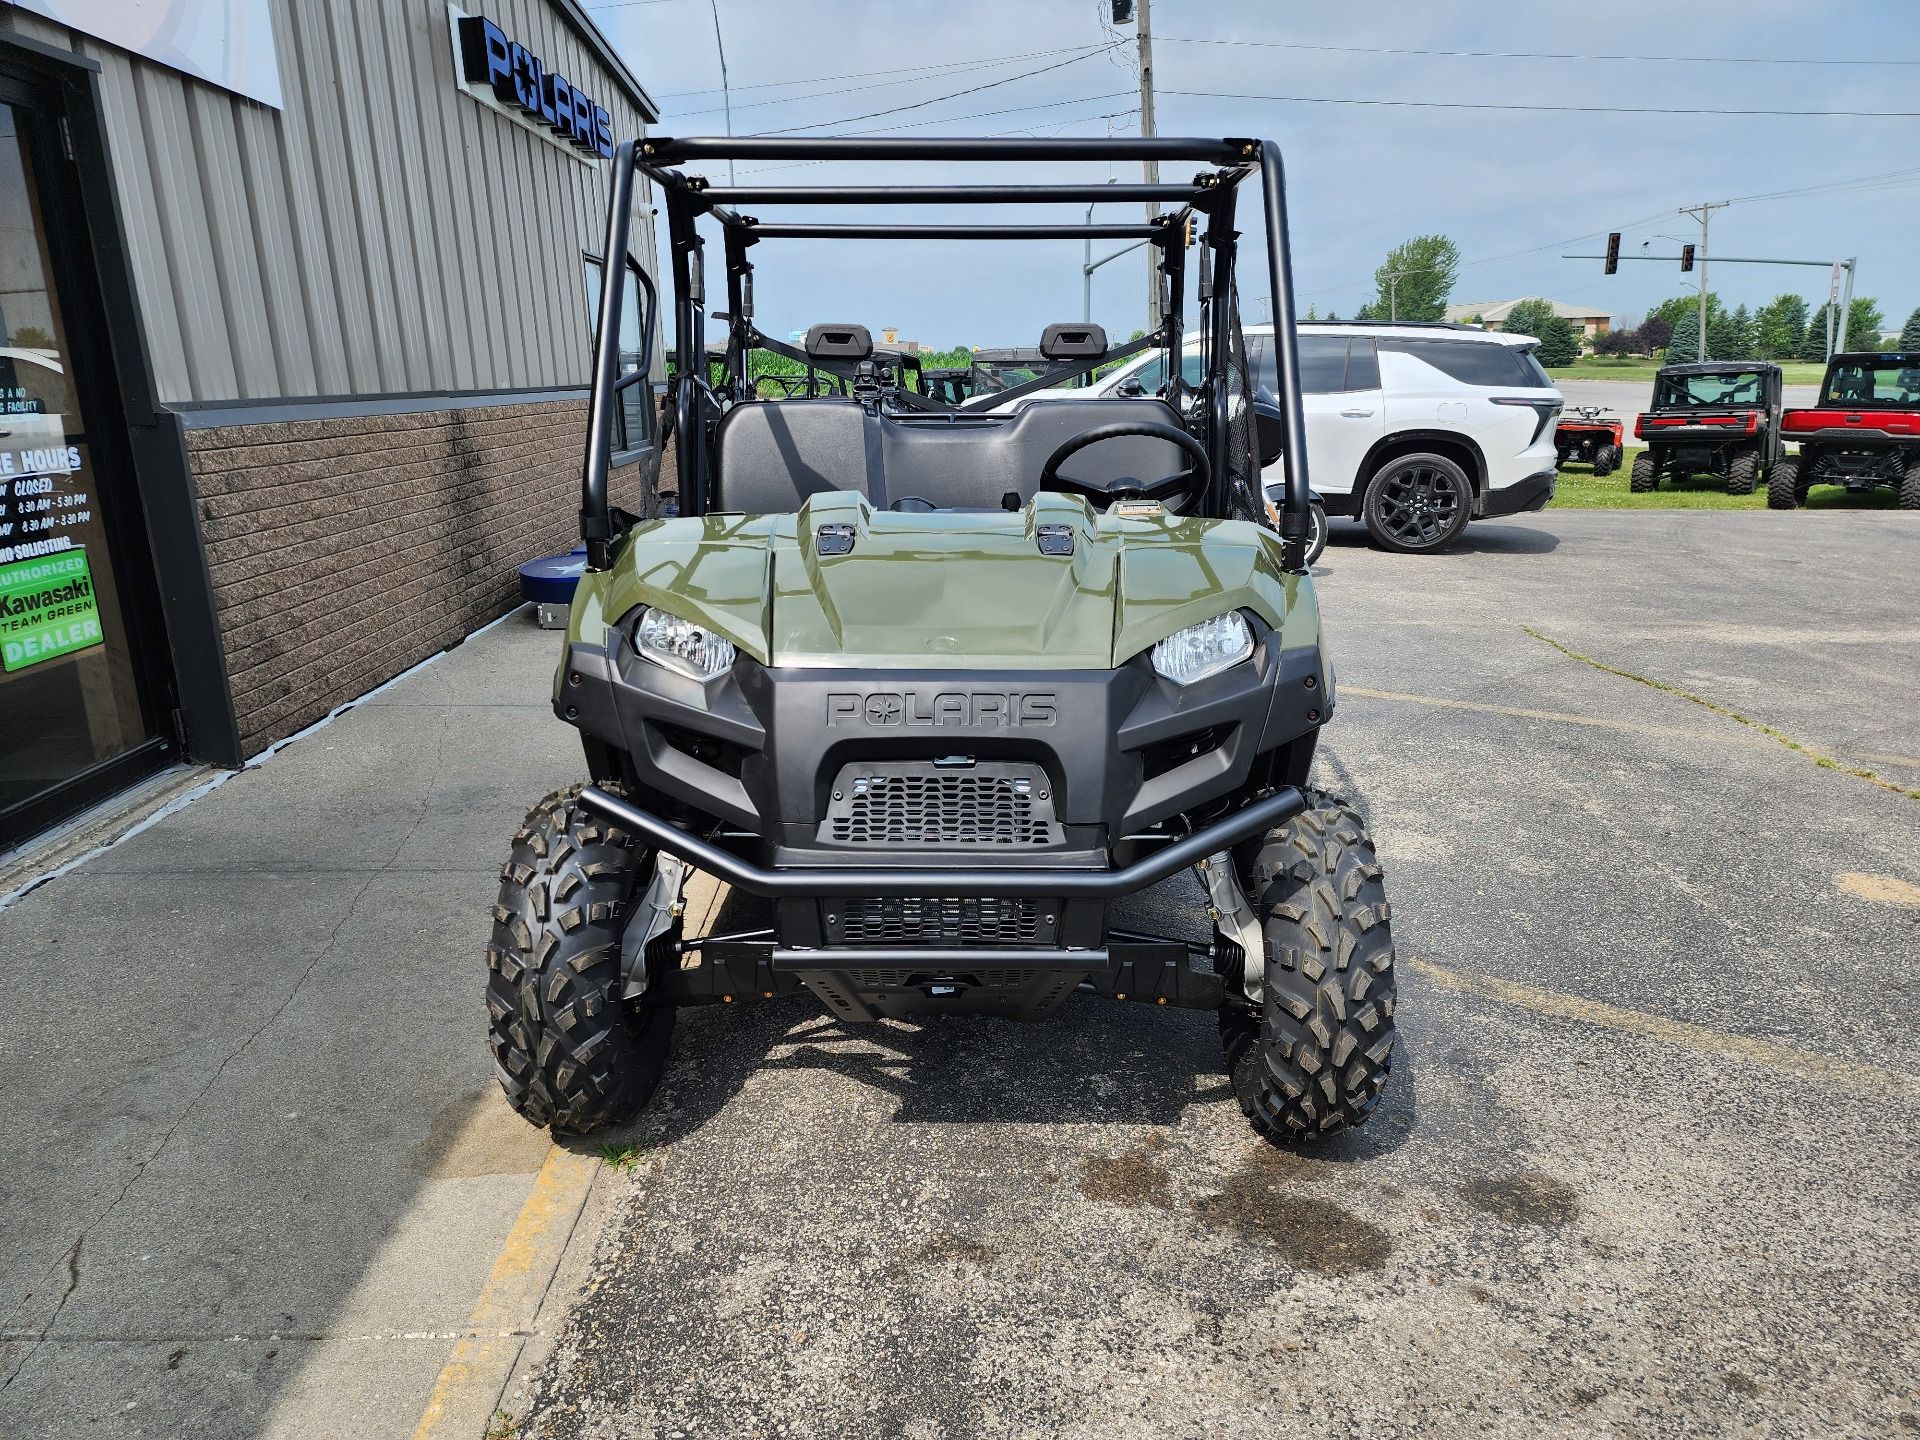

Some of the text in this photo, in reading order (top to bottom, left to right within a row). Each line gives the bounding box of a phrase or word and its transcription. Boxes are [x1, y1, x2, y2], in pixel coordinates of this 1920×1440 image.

[482, 16, 613, 160] POLARIS
[7, 387, 13, 398] A
[16, 388, 25, 397] NO
[7, 400, 37, 412] FACILITY
[21, 447, 81, 471] HOURS
[14, 478, 53, 496] CLOSED
[14, 536, 71, 559] SOLICITING
[0, 557, 84, 586] UTHORIZED
[0, 576, 90, 618] Kawasaki
[2, 600, 92, 633] TEAM GREEN
[5, 619, 99, 663] DEALER
[827, 692, 1057, 727] POLARIS
